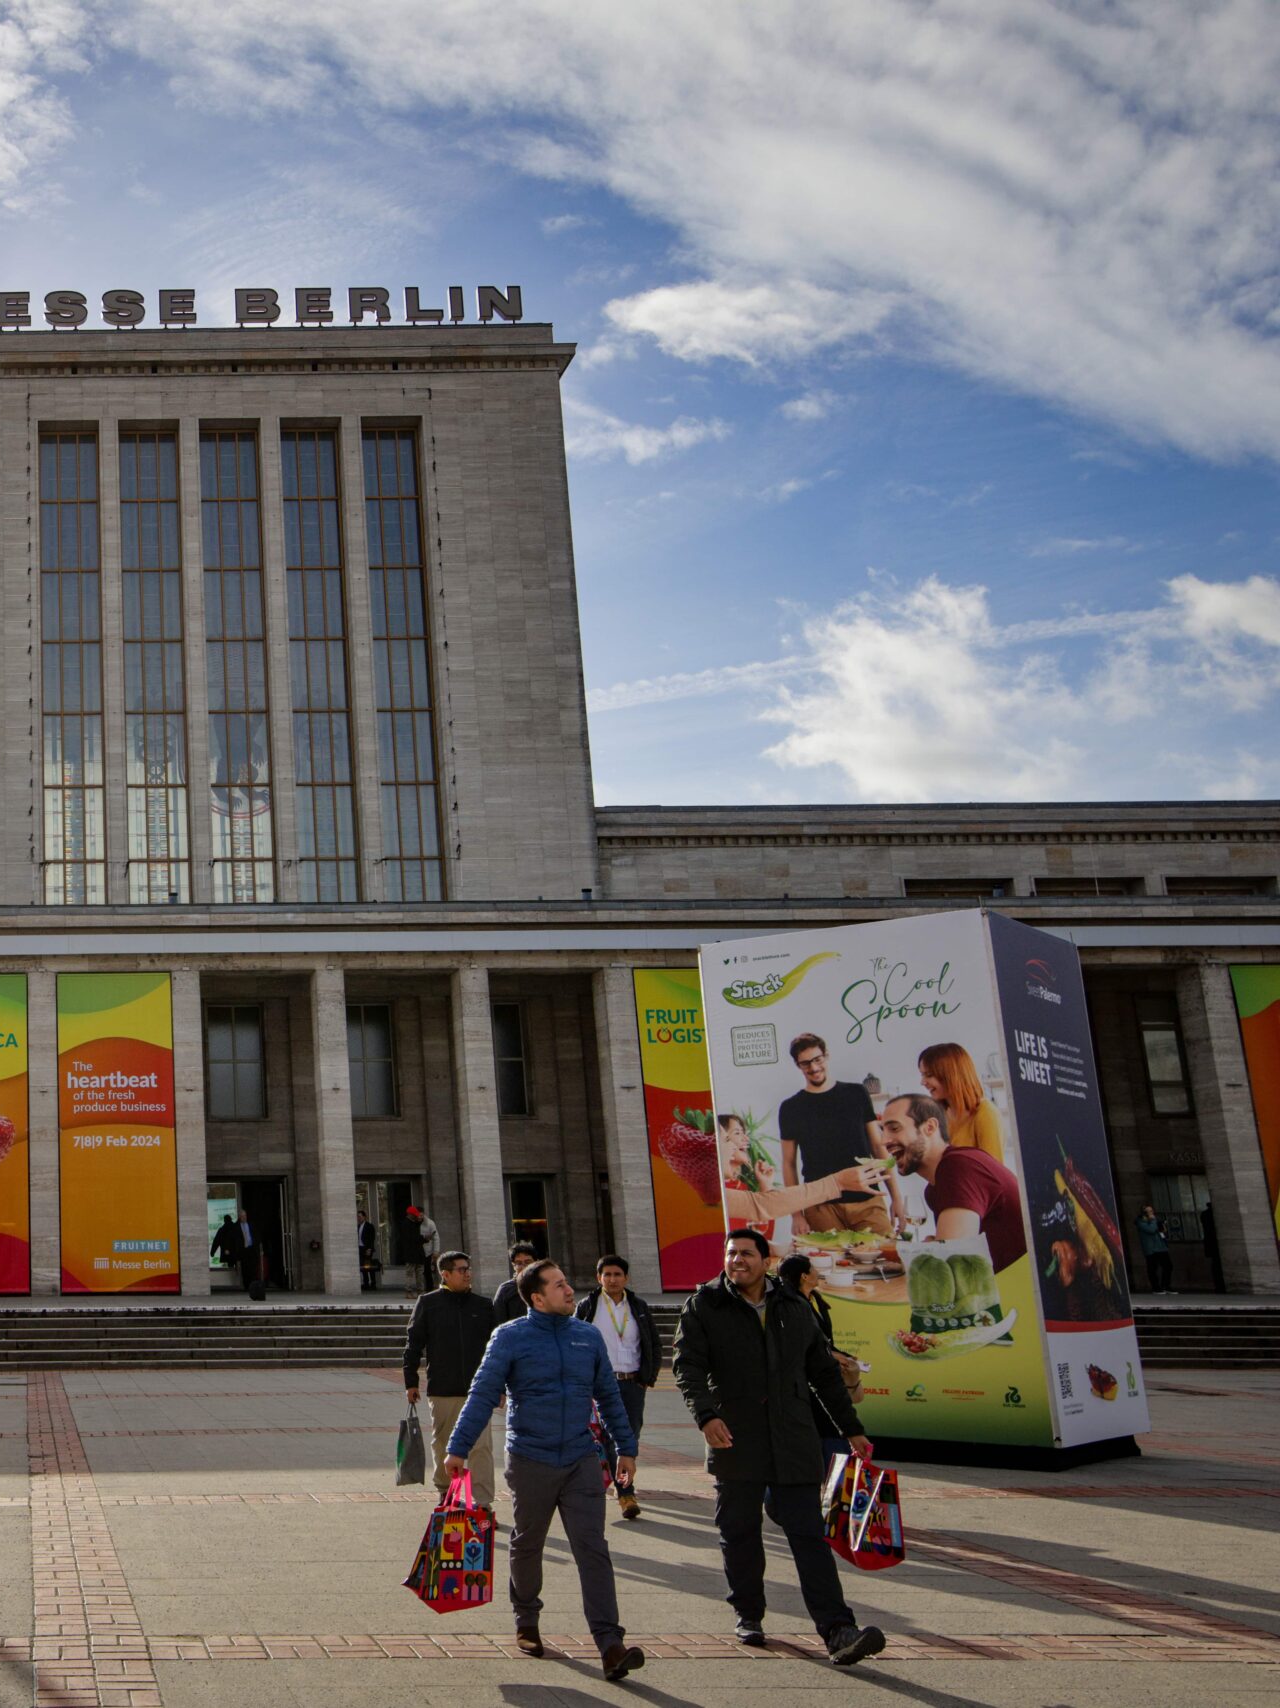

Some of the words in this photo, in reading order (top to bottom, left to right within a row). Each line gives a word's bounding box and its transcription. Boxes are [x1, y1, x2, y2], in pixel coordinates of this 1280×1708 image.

[234, 285, 524, 324] BERLIN
[869, 956, 891, 977] The
[730, 973, 785, 999] Snack
[883, 961, 955, 1006] Cool
[645, 1009, 698, 1024] FRUIT
[841, 979, 961, 1044] Spoon
[647, 1027, 705, 1044] LOGIS
[736, 1031, 770, 1040] REDUCES
[737, 1042, 771, 1051] PROTECTS
[1014, 1029, 1037, 1057] LIFE
[1037, 1035, 1049, 1059] IS
[738, 1050, 772, 1060] NATURE
[72, 1061, 93, 1072] The
[1018, 1057, 1052, 1086] SWEET
[67, 1071, 158, 1089] heartbeat
[73, 1090, 84, 1100] of
[86, 1090, 104, 1100] the
[107, 1089, 135, 1100] fresh
[73, 1101, 117, 1114] produce
[120, 1101, 166, 1112] business
[105, 1135, 128, 1147] Feb
[130, 1135, 161, 1147] 2024
[114, 1241, 168, 1250] FRUITNET
[112, 1260, 141, 1269] Messe
[143, 1259, 171, 1269] Berlin
[931, 1302, 956, 1312] Snack
